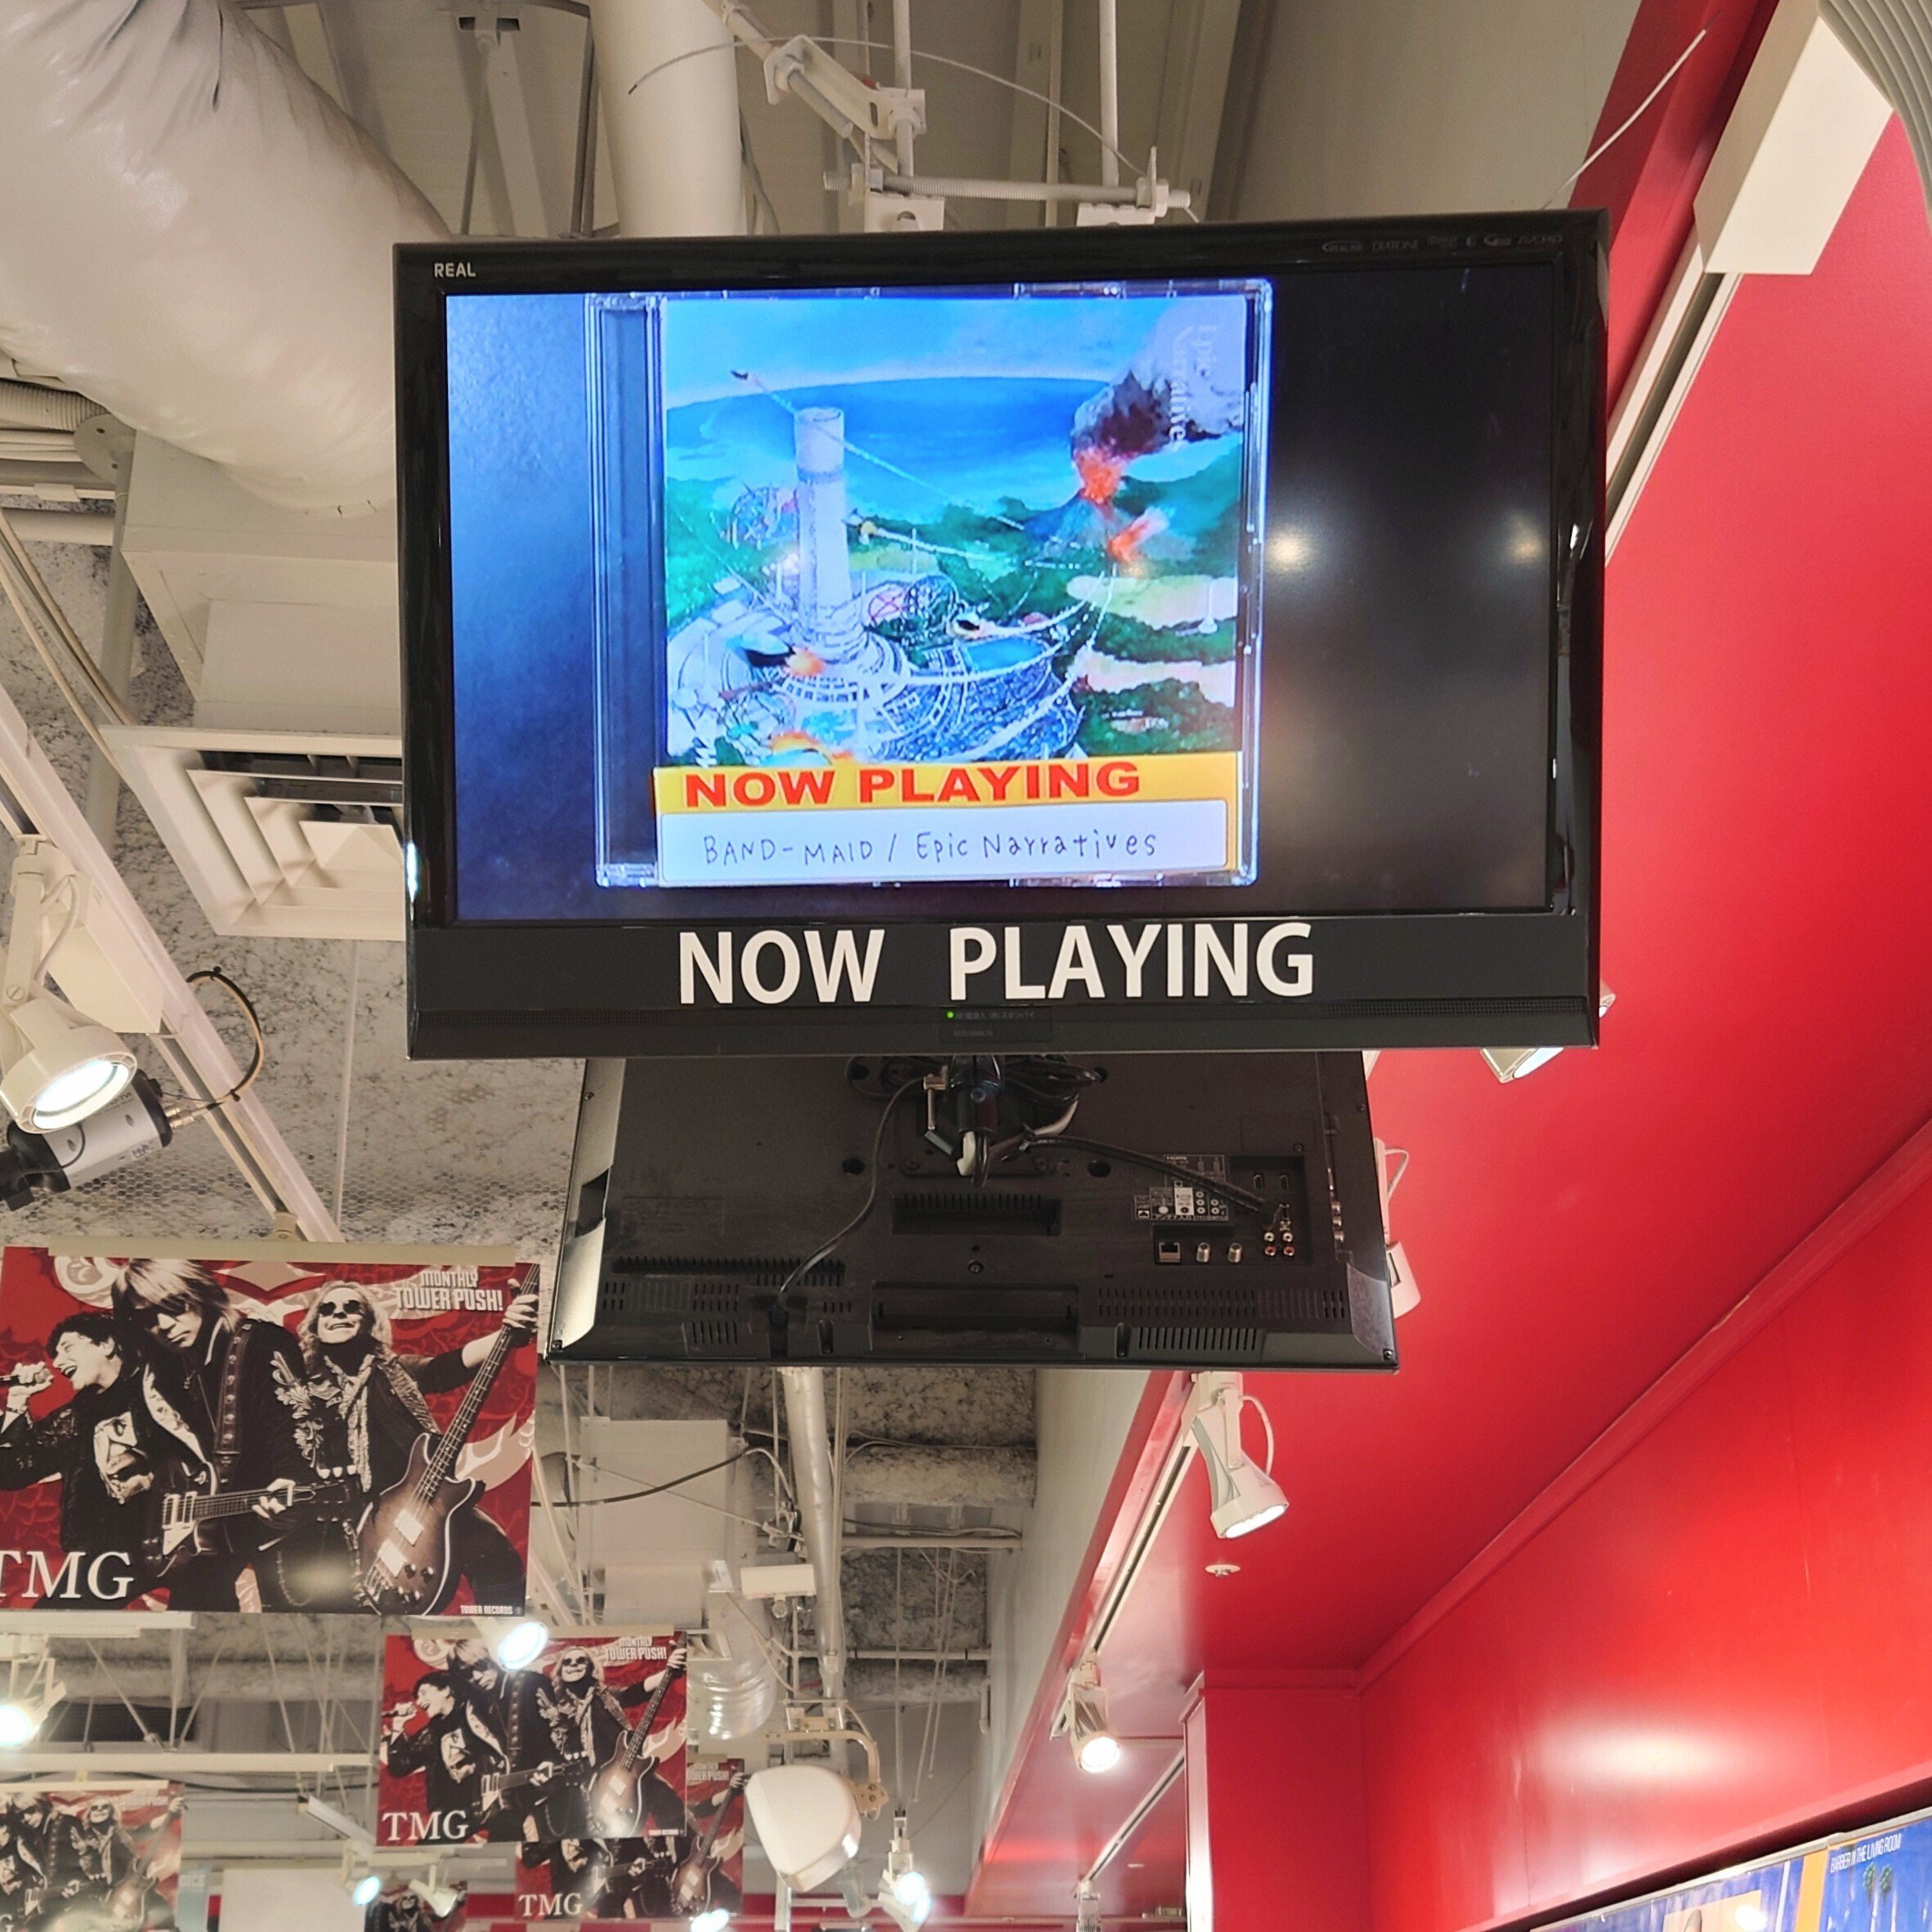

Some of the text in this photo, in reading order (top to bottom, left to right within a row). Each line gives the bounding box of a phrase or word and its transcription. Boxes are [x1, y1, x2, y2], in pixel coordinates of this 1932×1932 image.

[433, 262, 476, 278] REAL
[685, 761, 1141, 808] NOW PLAYING
[704, 834, 873, 865] BAND-MAID
[916, 831, 968, 863] Epic
[983, 829, 1156, 859] Narratives
[679, 922, 1313, 1004] NOW PLAYING
[422, 1271, 479, 1288] MONTHLY
[395, 1287, 504, 1312] TOWER PUSH!
[460, 1604, 483, 1615] TOWER
[606, 1647, 668, 1661] TOWER PUSH!
[382, 1810, 469, 1841] TMG
[518, 1892, 583, 1917] TMG
